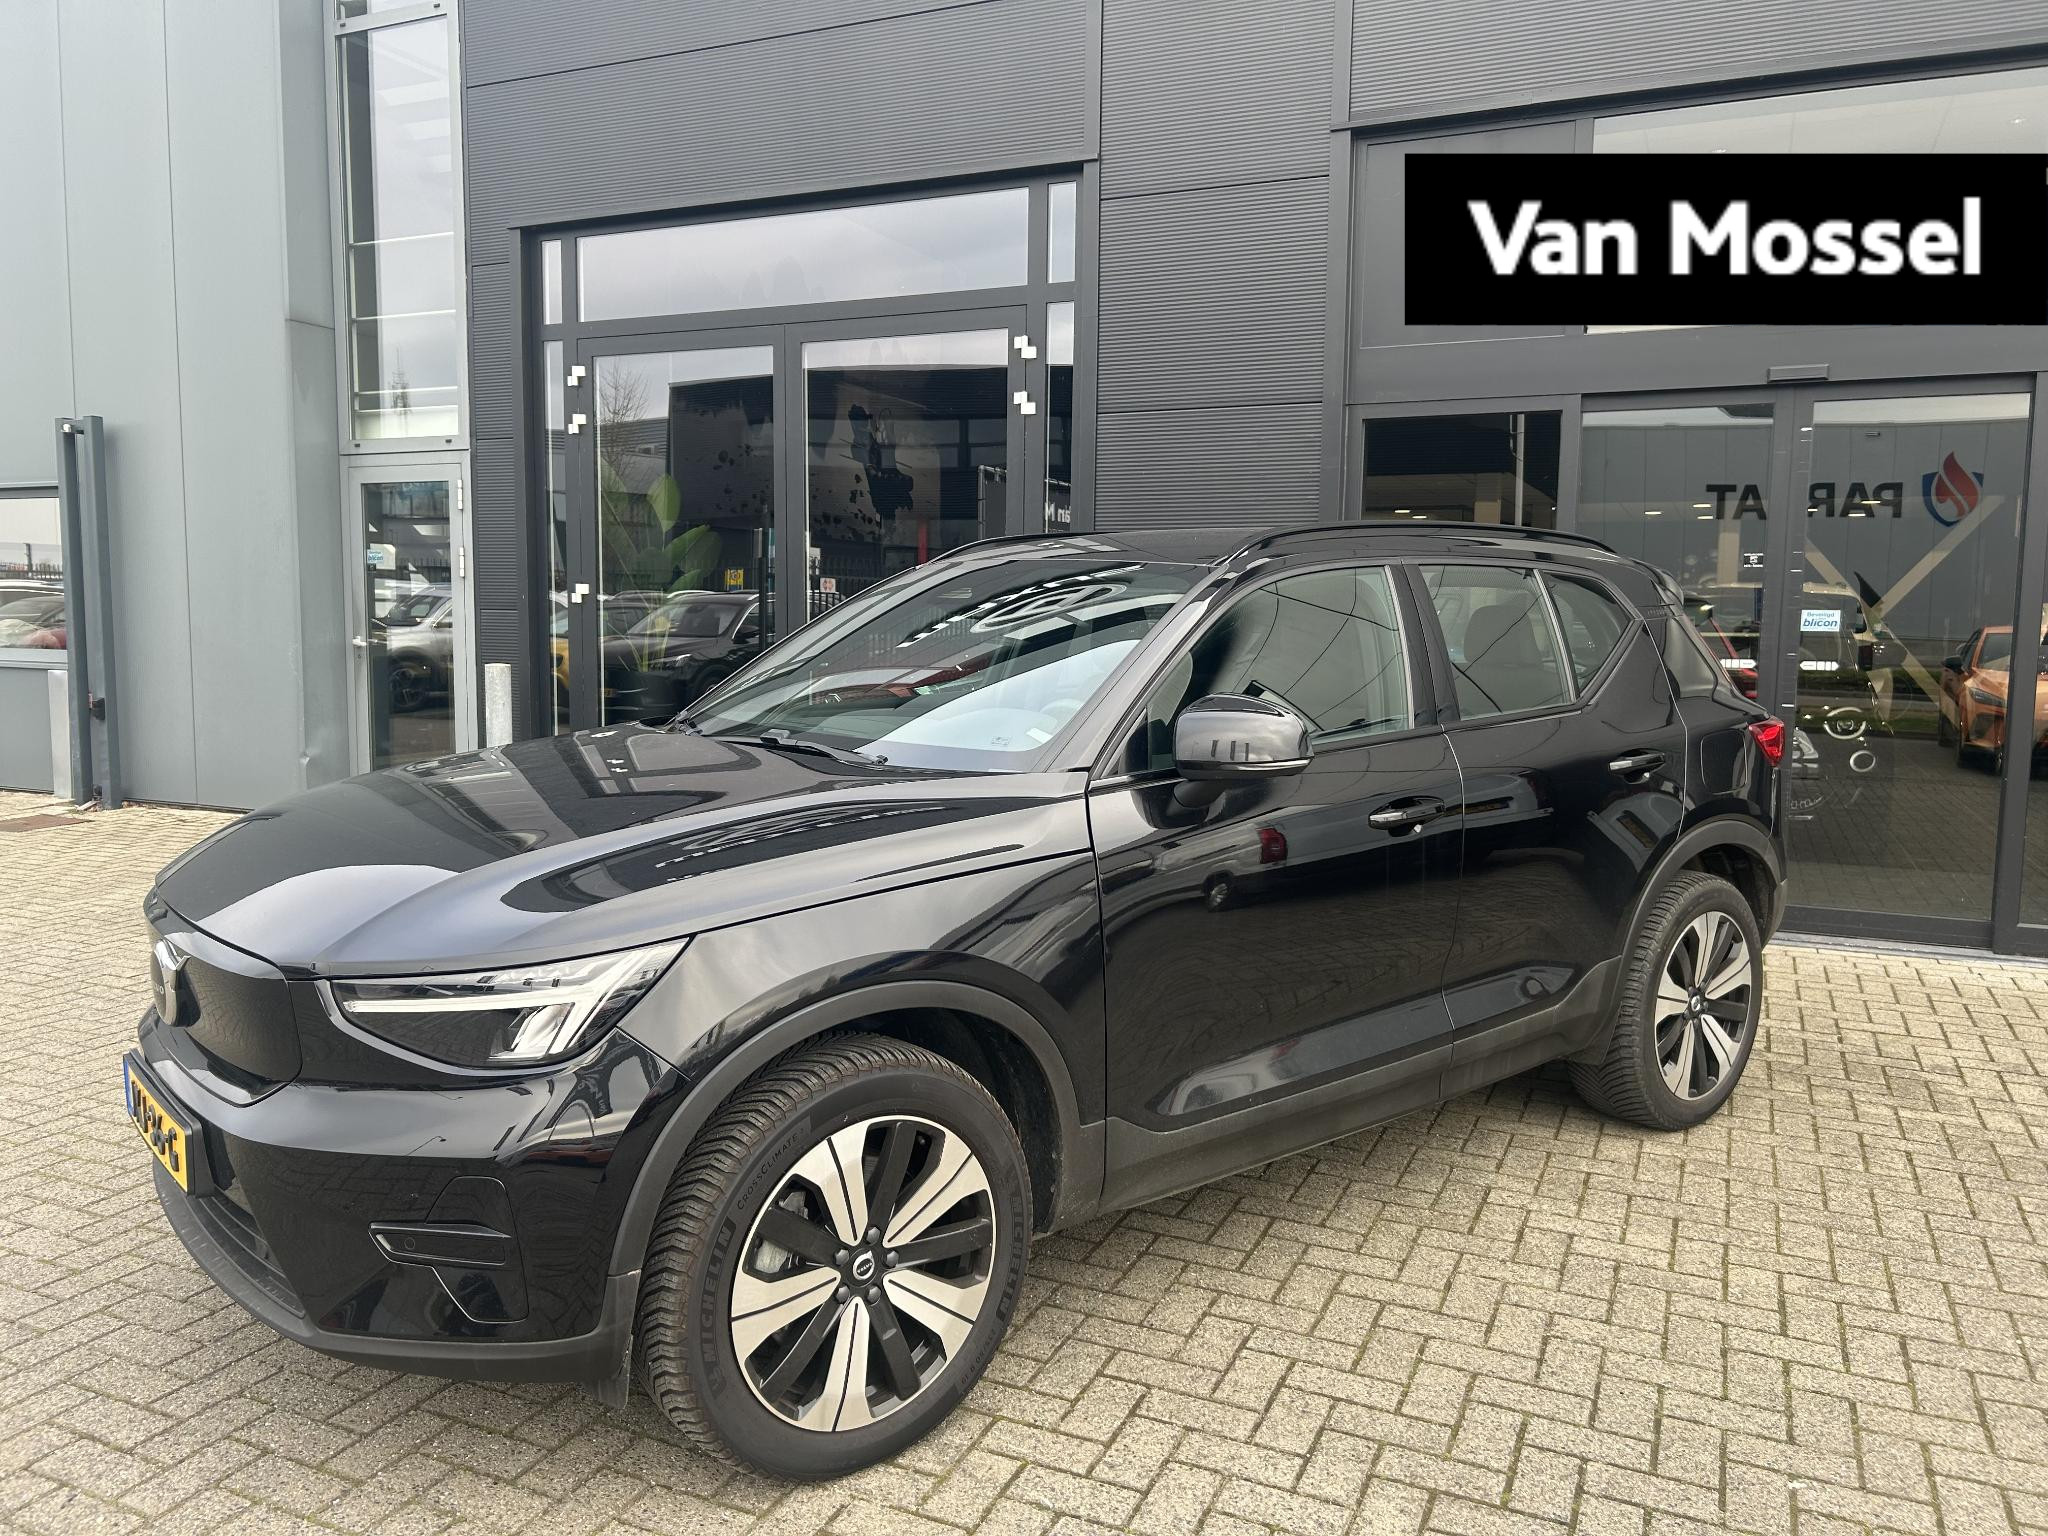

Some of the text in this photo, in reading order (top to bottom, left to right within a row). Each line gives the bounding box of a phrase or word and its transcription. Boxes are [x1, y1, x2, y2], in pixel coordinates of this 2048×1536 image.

[1802, 618, 1839, 628] blicon
[736, 1133, 798, 1211] CROSSCLIMATE
[702, 1225, 732, 1363] MICHELIN
